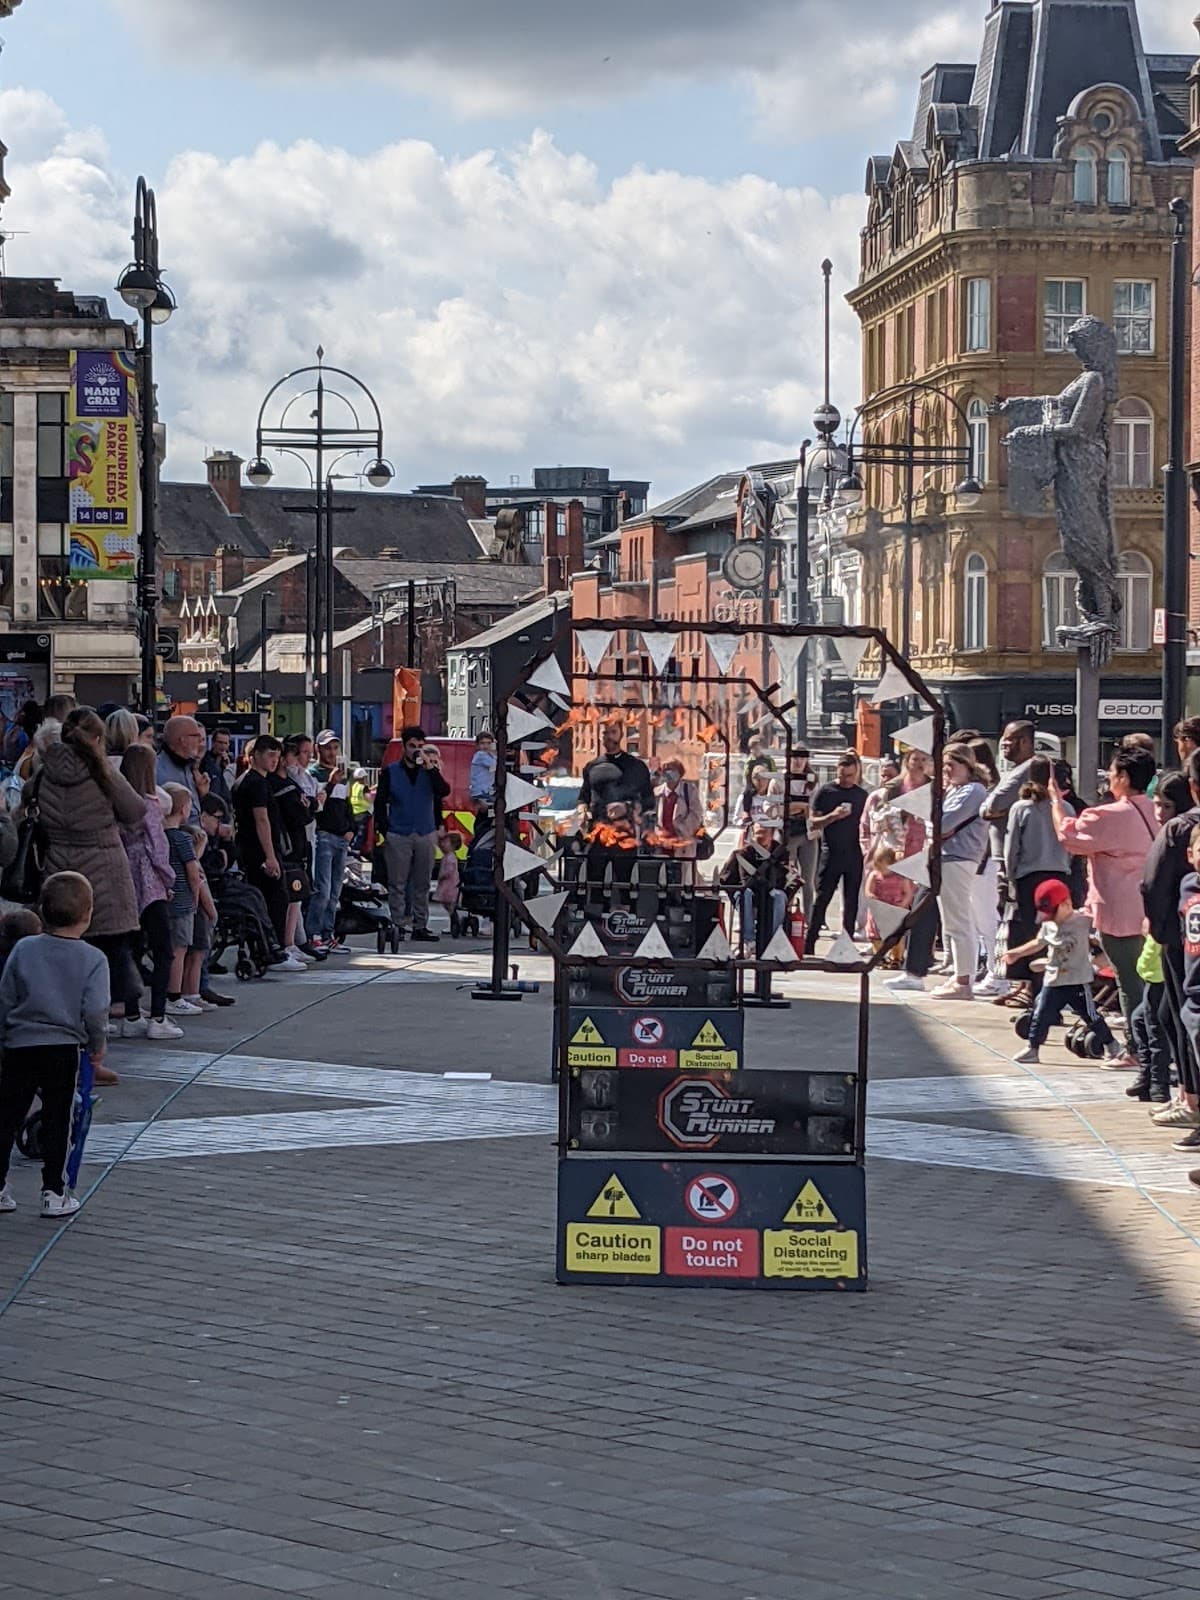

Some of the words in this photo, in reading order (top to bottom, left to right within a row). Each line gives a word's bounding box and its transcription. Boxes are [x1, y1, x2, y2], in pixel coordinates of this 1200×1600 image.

[84, 386, 121, 396] MARDI
[86, 396, 118, 406] GRAS
[117, 423, 128, 501] ROUNDHAY
[106, 464, 116, 504] LEEDS
[79, 511, 90, 520] 14
[114, 511, 125, 520] 21
[627, 969, 674, 983] STUNT
[632, 983, 689, 996] RUNNER
[628, 1053, 646, 1063] Do
[648, 1054, 667, 1064] not
[679, 1092, 755, 1114] STUNT
[685, 1112, 776, 1134] RUNNER
[575, 1231, 652, 1250] Caution
[682, 1237, 707, 1252] Do
[712, 1239, 743, 1253] not
[788, 1235, 832, 1246] Social
[575, 1251, 609, 1262] sharp
[611, 1252, 651, 1263] blades
[686, 1253, 738, 1268] touch
[773, 1246, 847, 1261] Distancing
